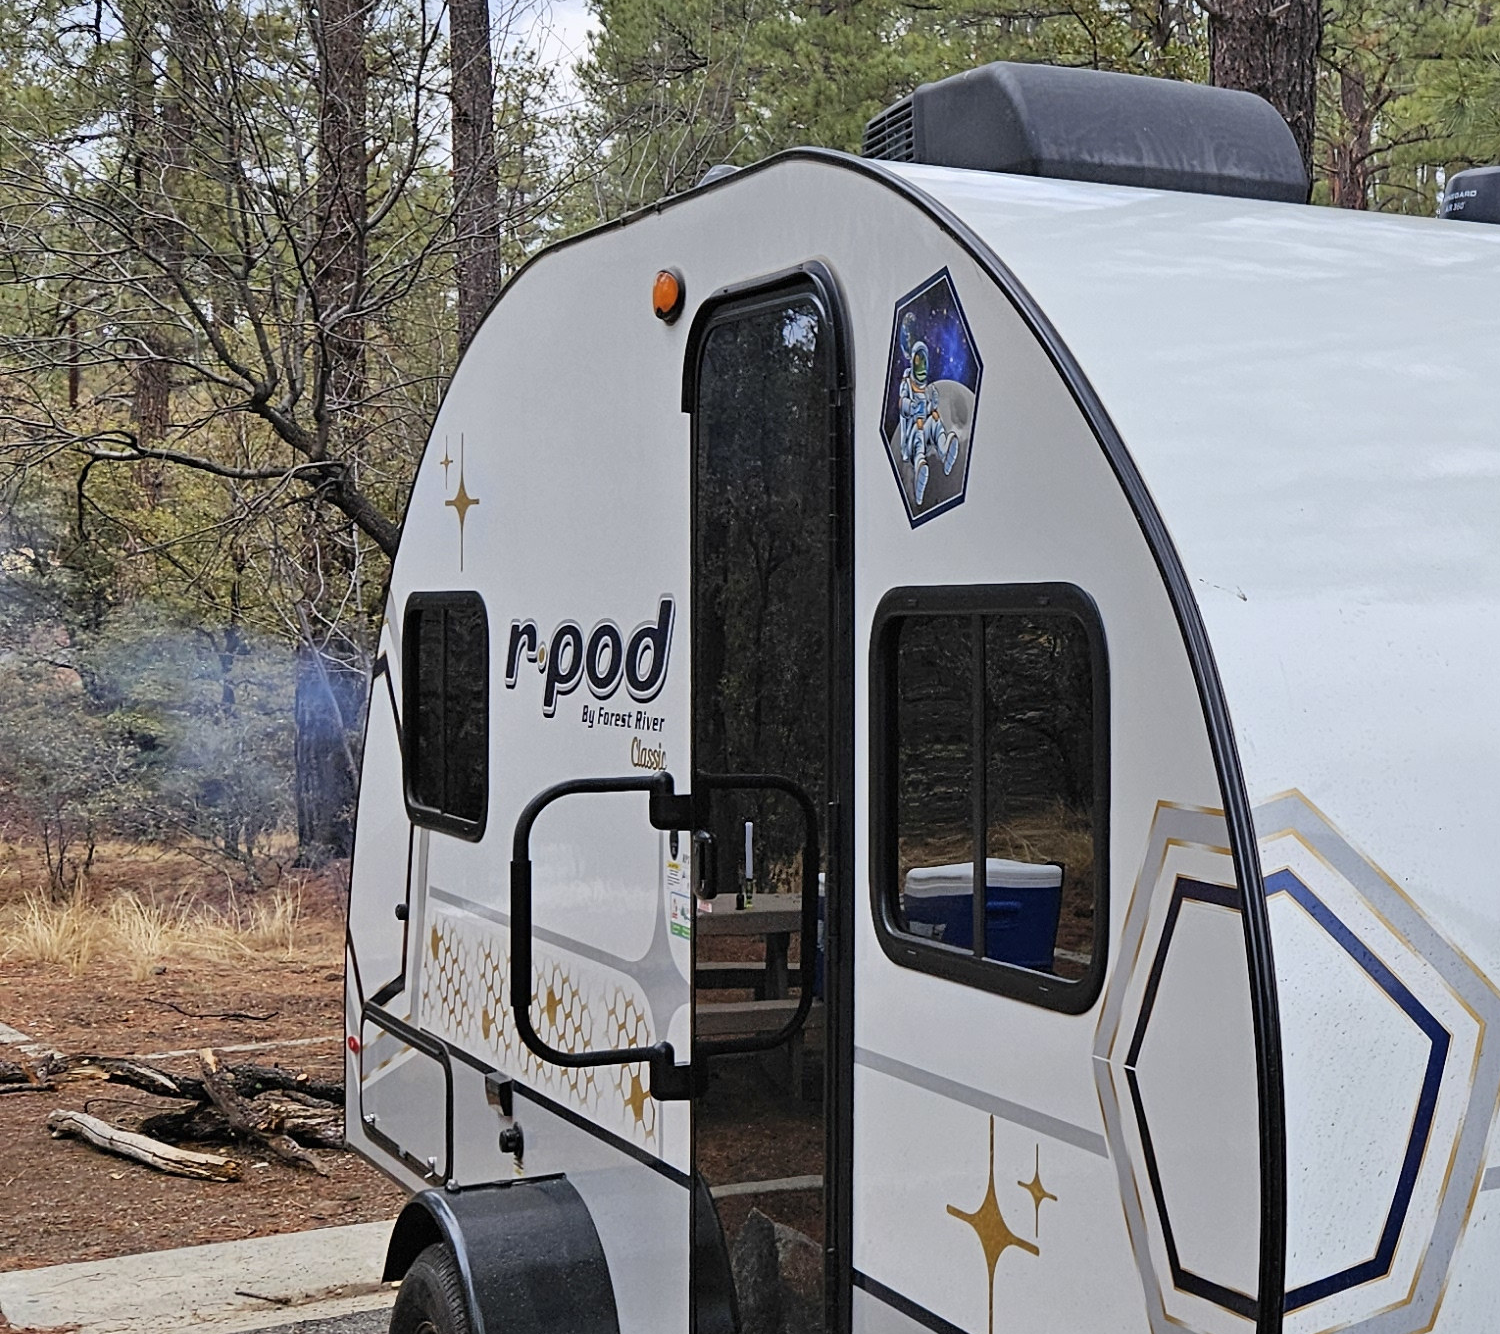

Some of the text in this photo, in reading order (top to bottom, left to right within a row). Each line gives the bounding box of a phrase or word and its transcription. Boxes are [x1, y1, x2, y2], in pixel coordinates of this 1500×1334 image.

[581, 705, 665, 732] By Forest River
[631, 736, 667, 771] Classic
